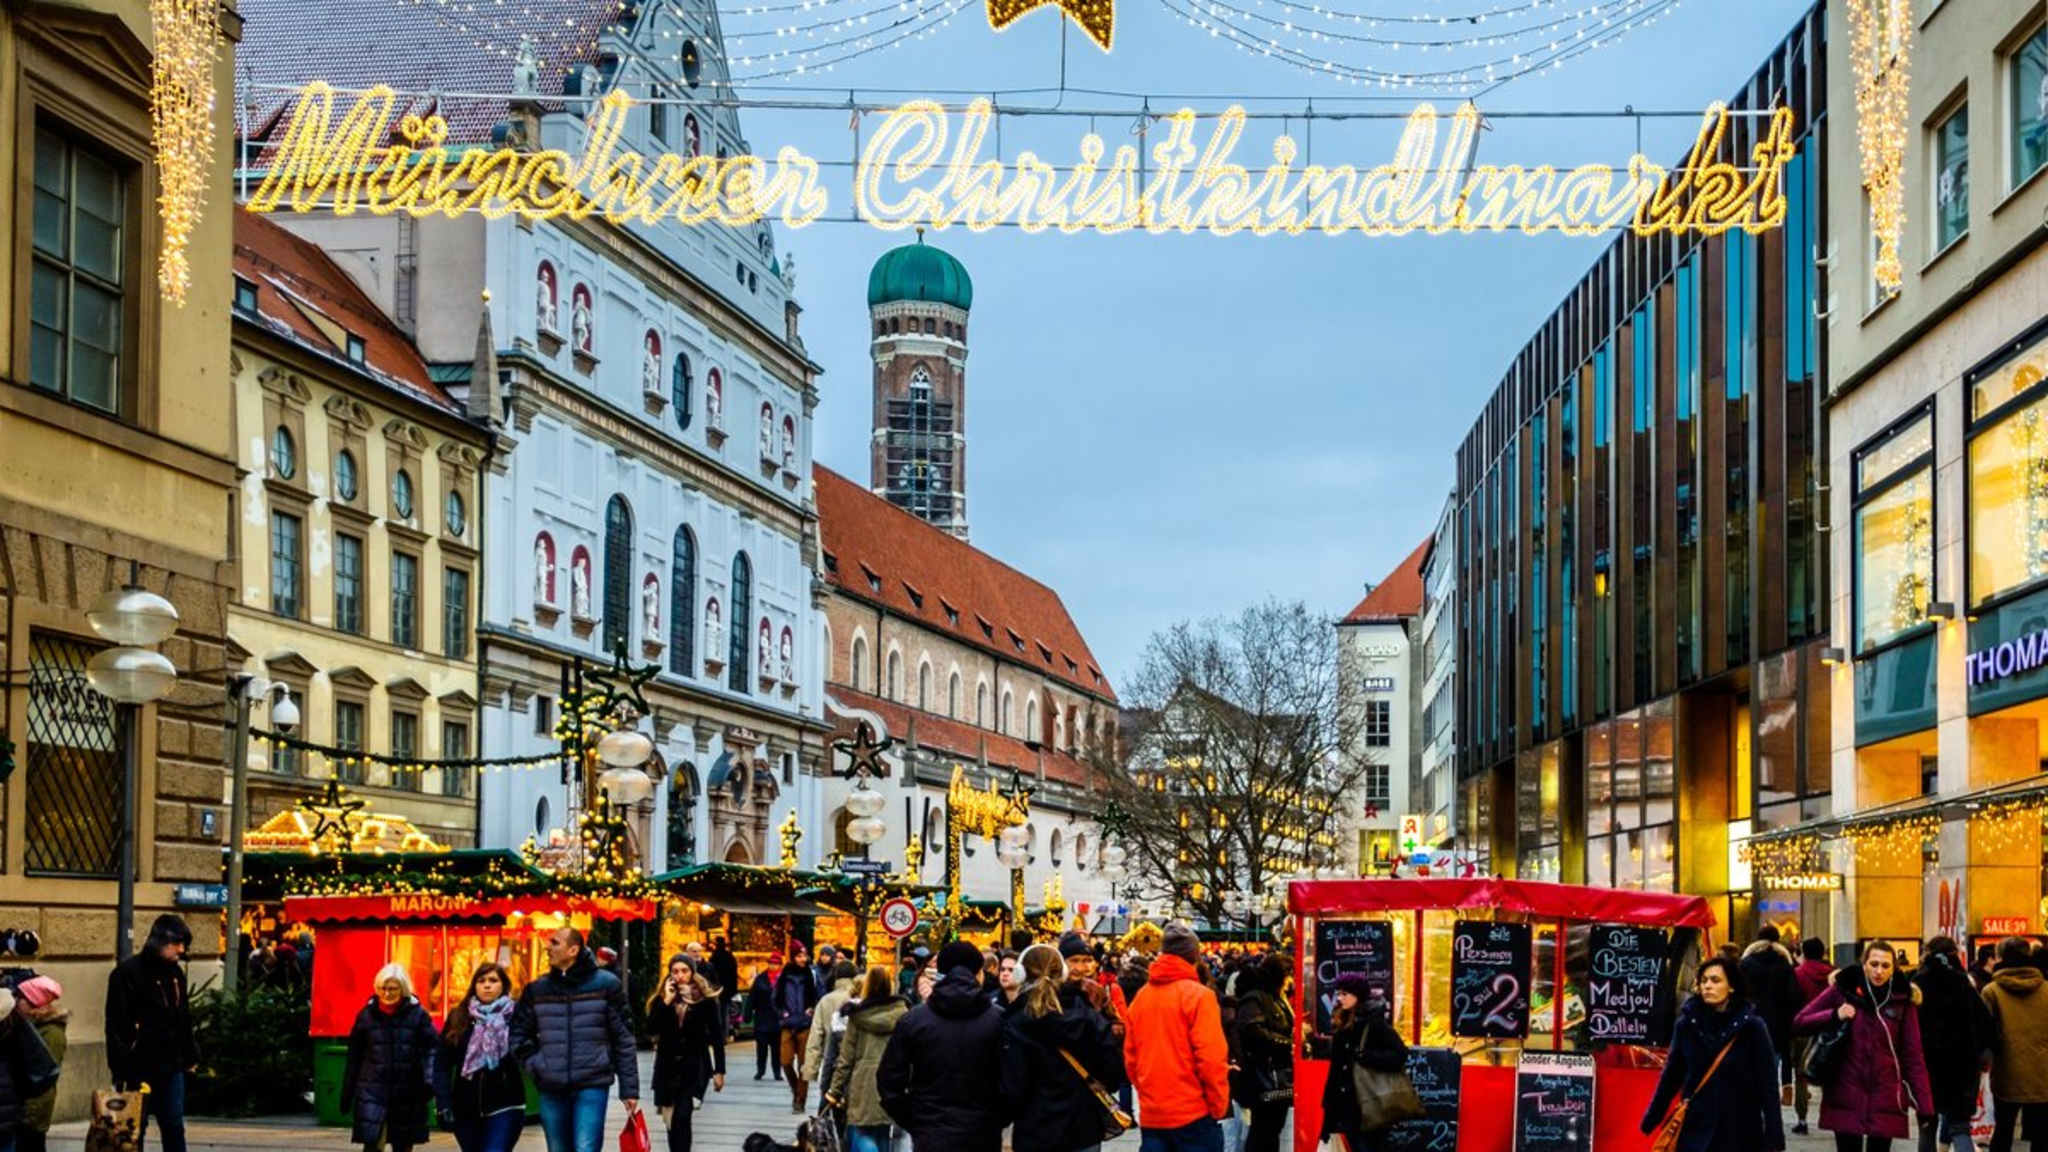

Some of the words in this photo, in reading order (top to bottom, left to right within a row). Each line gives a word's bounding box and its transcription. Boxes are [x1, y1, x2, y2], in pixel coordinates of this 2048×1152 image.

[243, 80, 830, 227] Münchner
[853, 96, 1798, 238] Christkindlmarkt
[1764, 875, 1841, 889] THOMAS
[1984, 919, 2009, 934] SALE
[1588, 1012, 1648, 1035] Datteln
